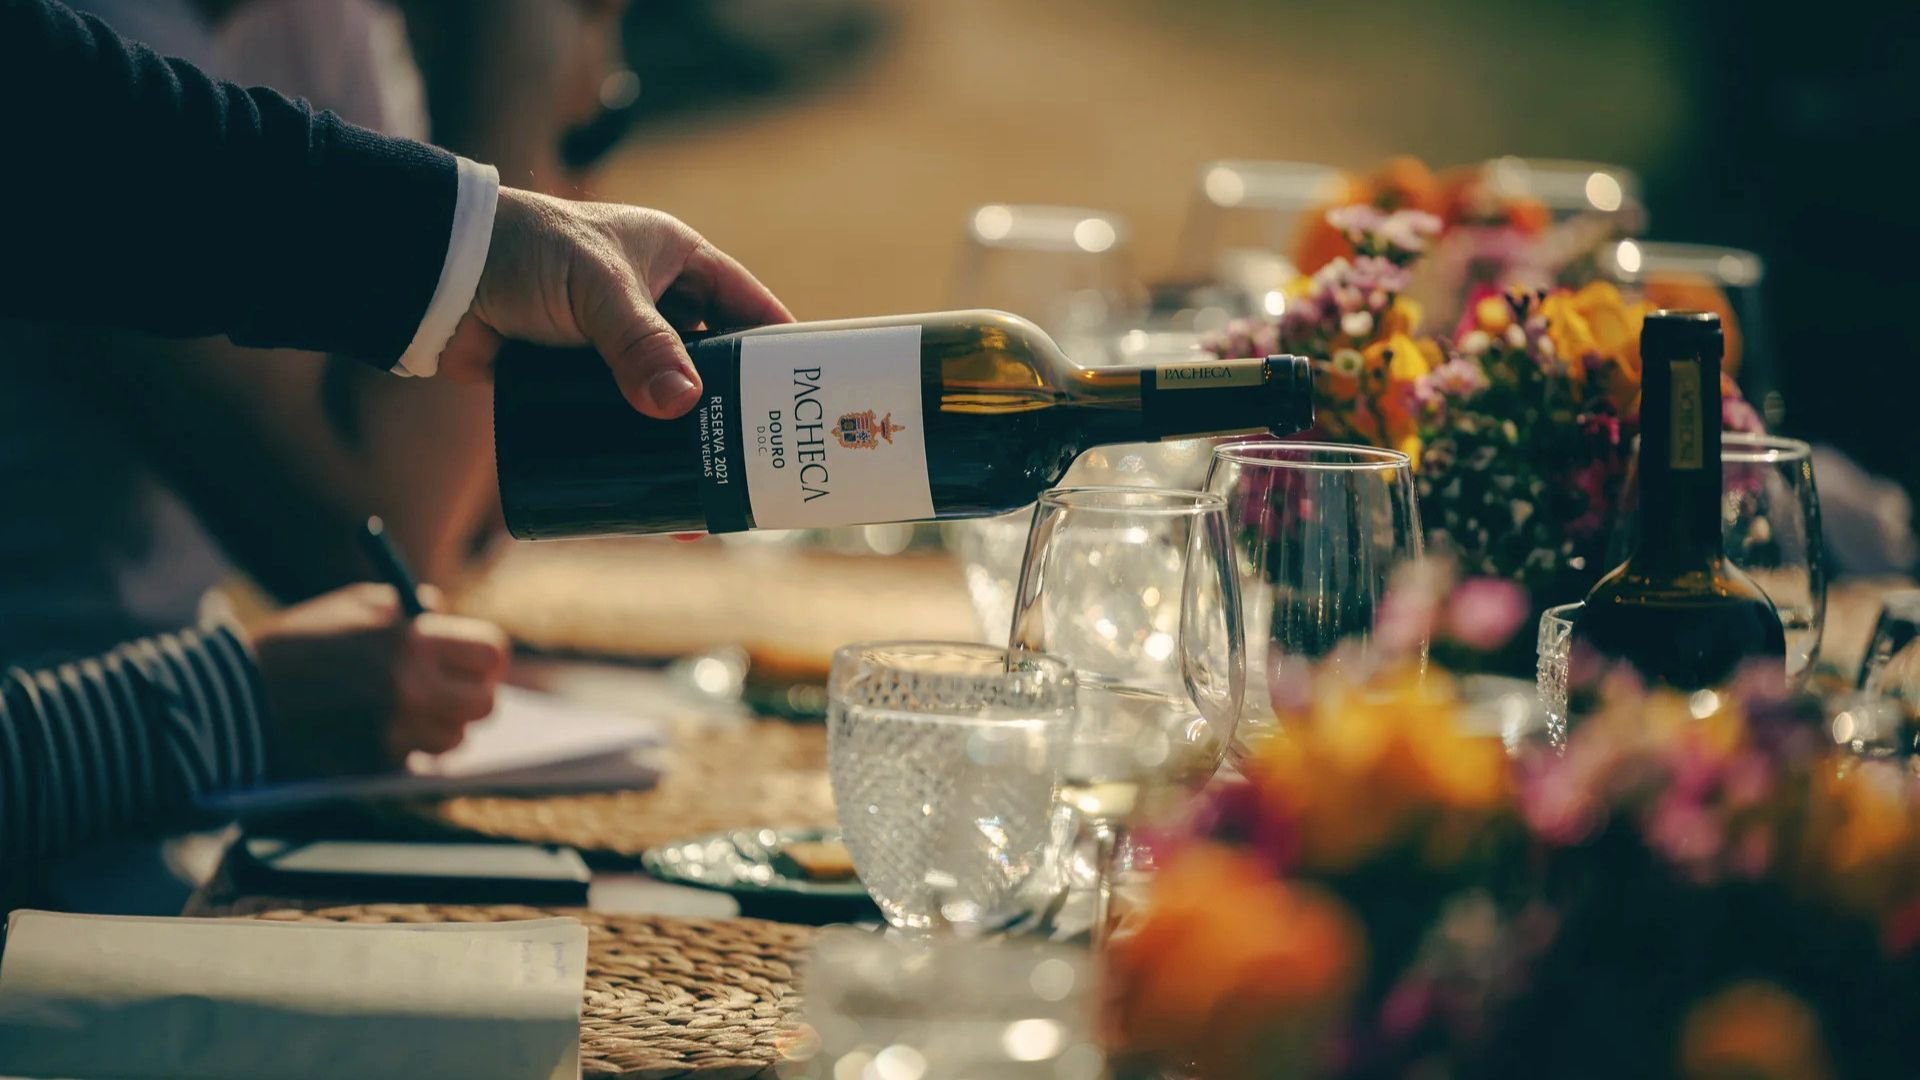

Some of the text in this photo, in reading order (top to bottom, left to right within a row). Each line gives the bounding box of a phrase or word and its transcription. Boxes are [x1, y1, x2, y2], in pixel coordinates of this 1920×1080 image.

[1164, 367, 1232, 380] PACHECA
[700, 407, 713, 477] VINHAS VELHAS
[711, 396, 728, 485] RESERVA 2021
[768, 410, 785, 469] DOURO
[793, 366, 830, 503] PACHECA
